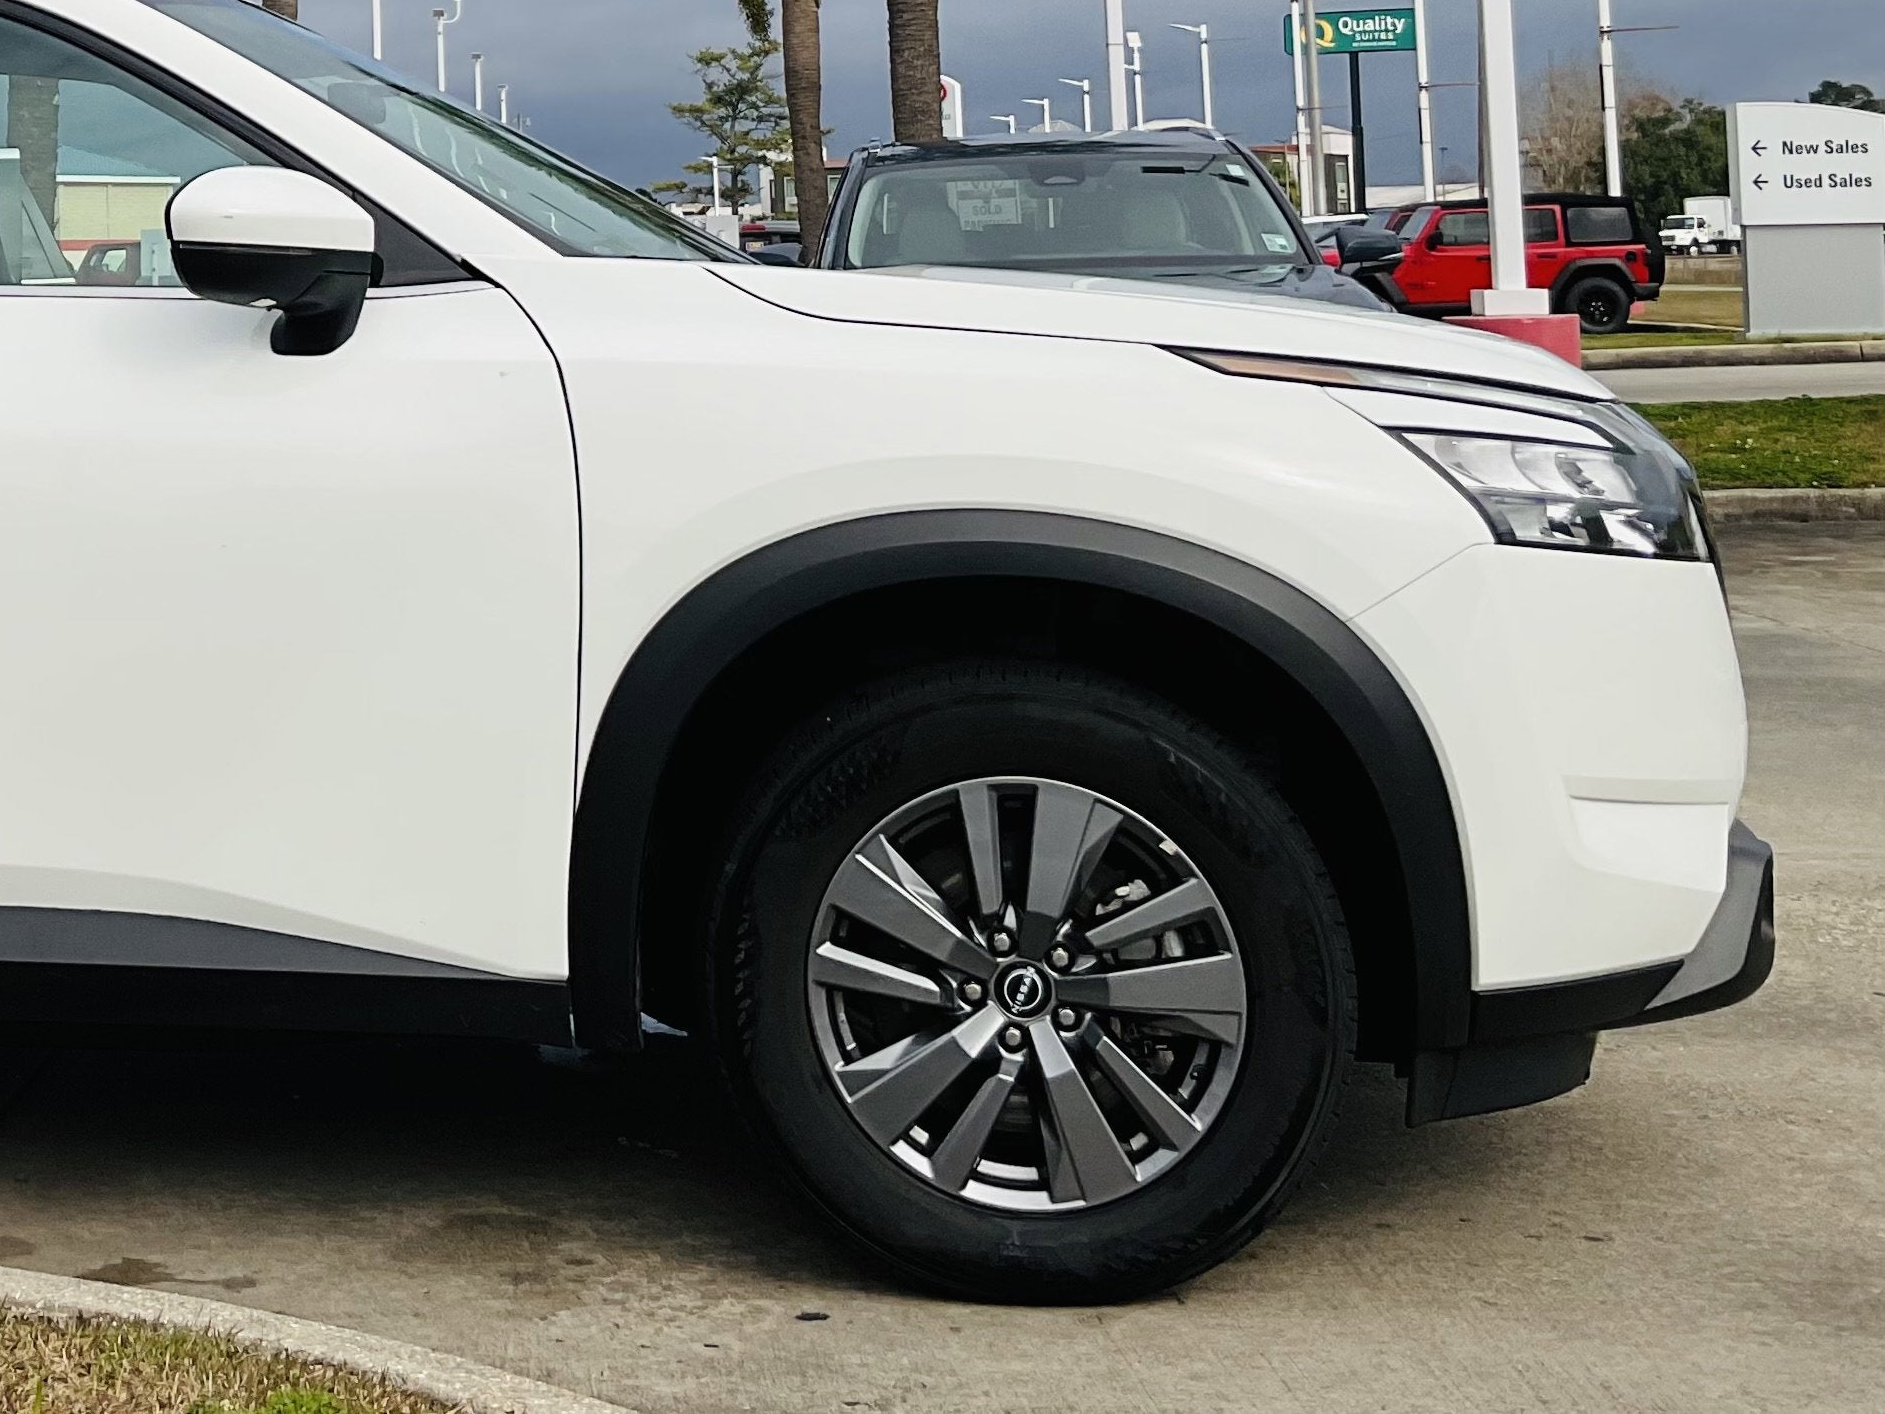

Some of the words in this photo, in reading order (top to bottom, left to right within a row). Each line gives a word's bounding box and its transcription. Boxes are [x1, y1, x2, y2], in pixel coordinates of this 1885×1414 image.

[1338, 15, 1405, 35] Quality
[1355, 32, 1394, 41] SUITES
[1782, 140, 1819, 155] New
[1824, 139, 1869, 154] Sales
[1783, 174, 1823, 189] Used
[1828, 173, 1872, 188] Sales
[972, 204, 1003, 216] SOLD
[1011, 966, 1036, 1014] NISSAN
